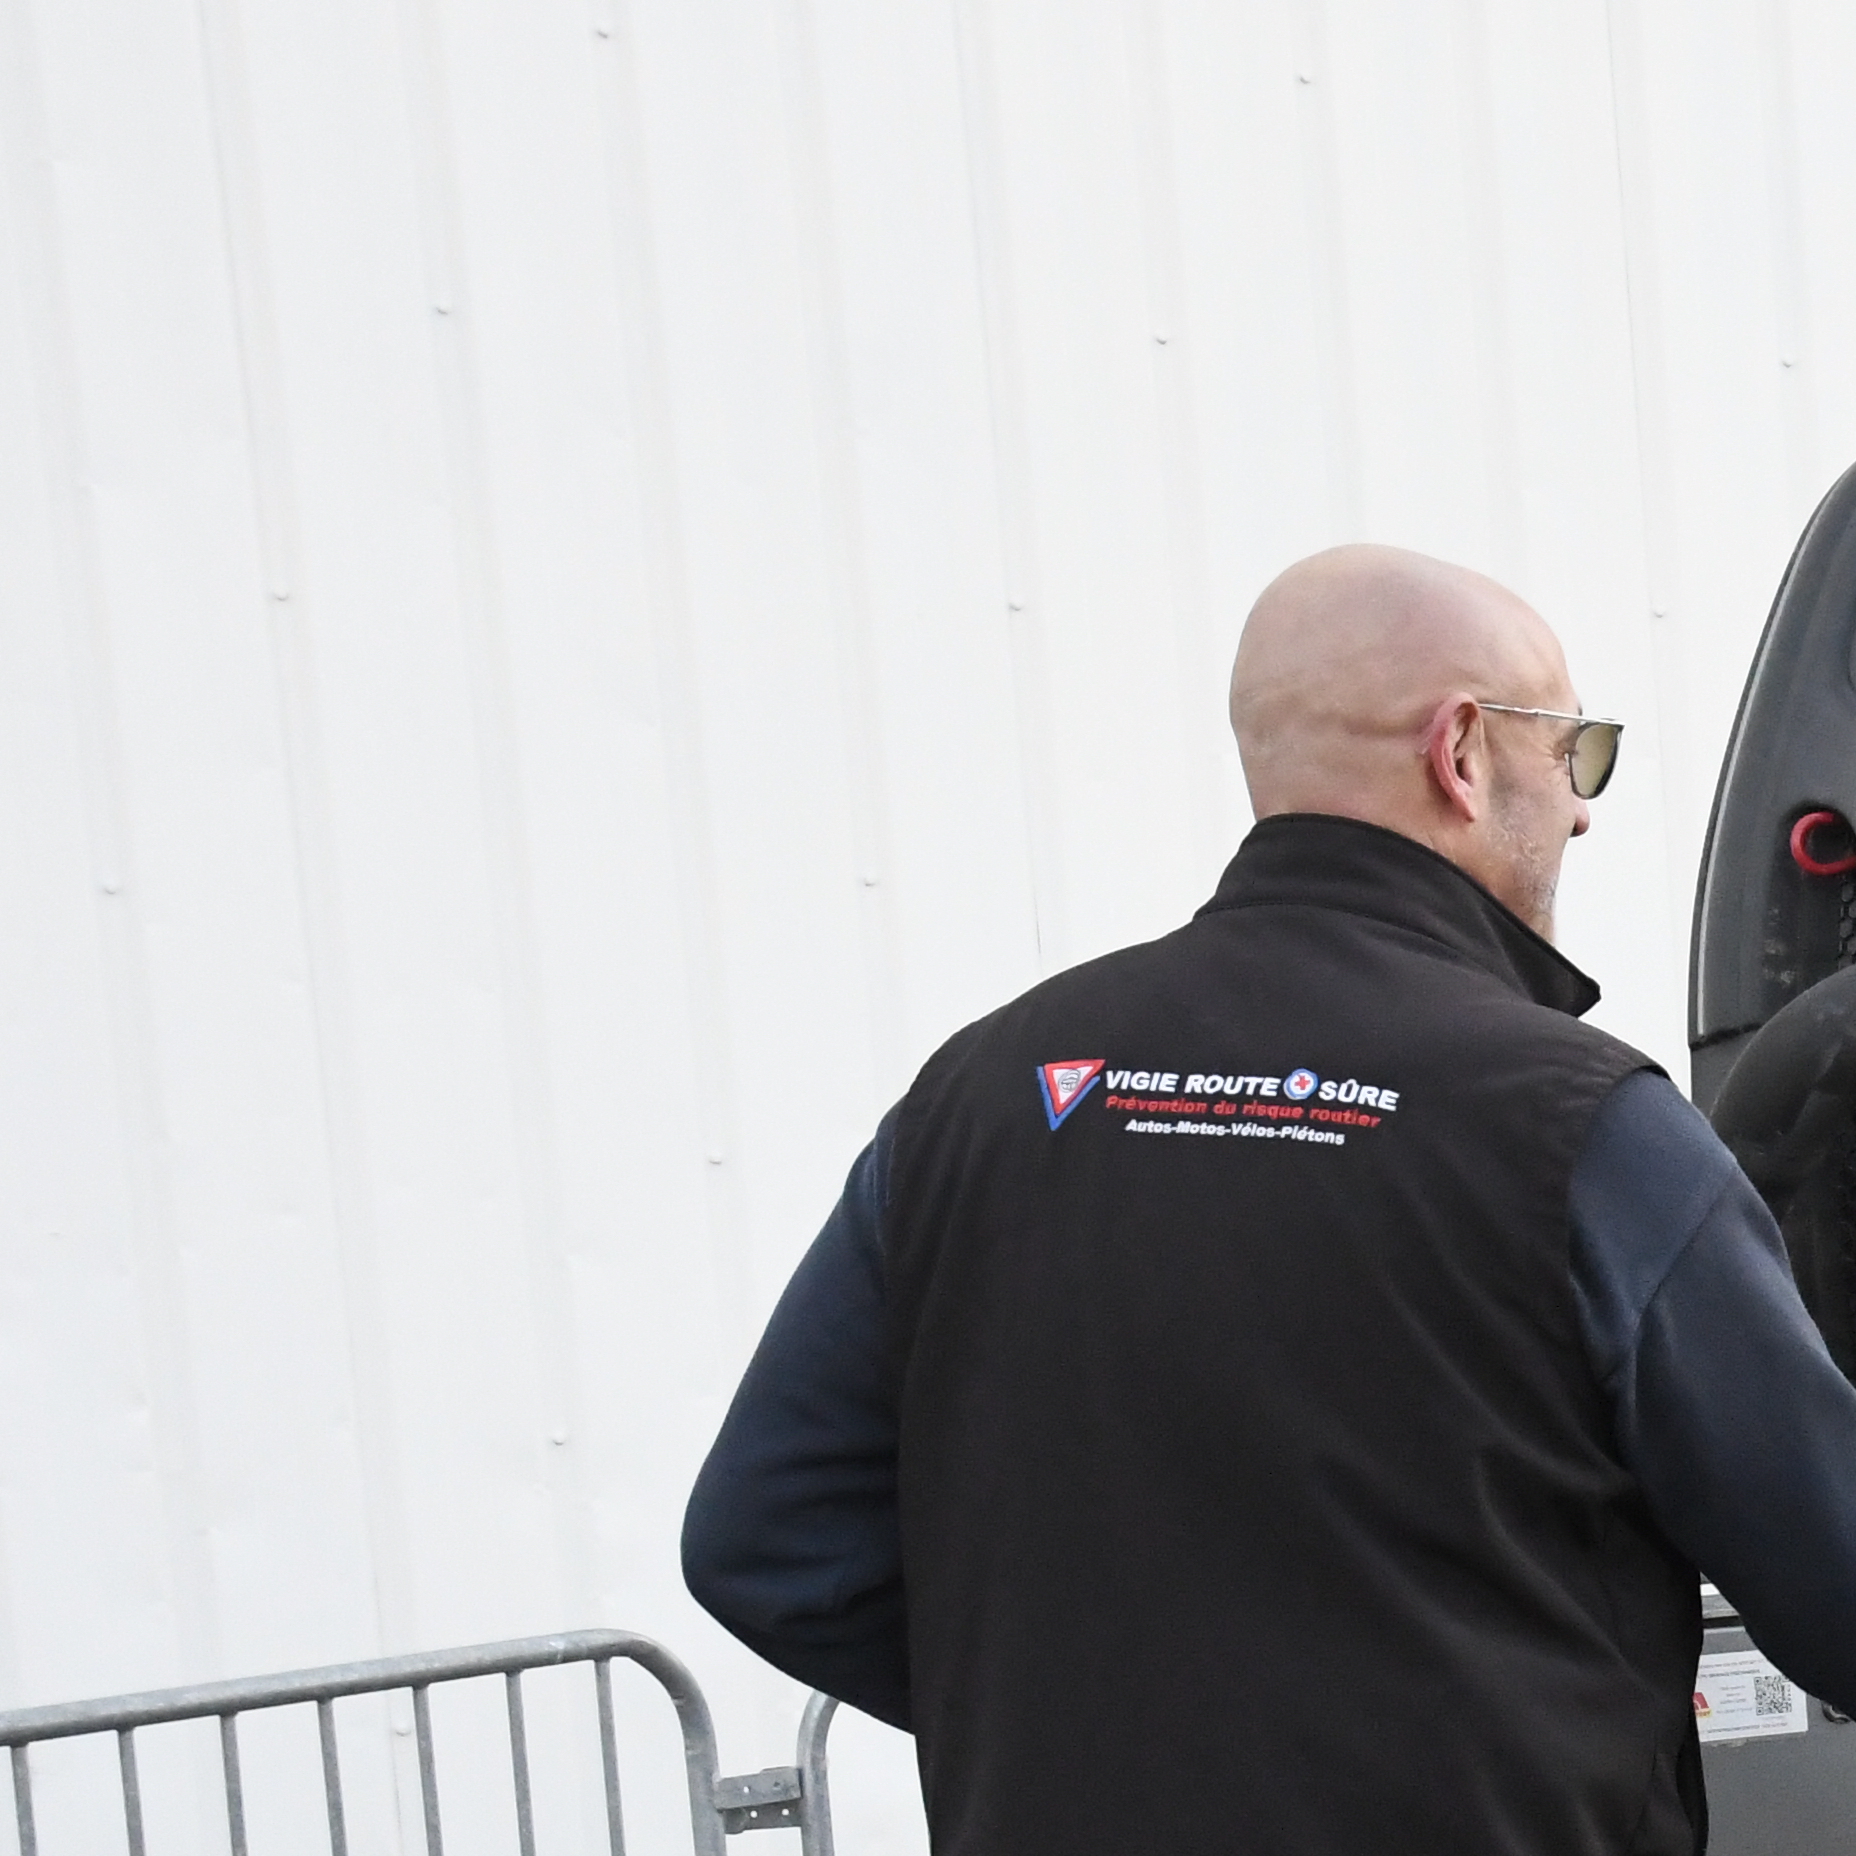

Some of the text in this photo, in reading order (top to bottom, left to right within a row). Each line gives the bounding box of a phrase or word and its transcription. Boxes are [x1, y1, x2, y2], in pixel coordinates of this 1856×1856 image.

[1105, 1070, 1399, 1111] VIGIE ROUTE SÛRE
[1105, 1094, 1381, 1128] Prévention du risque routier
